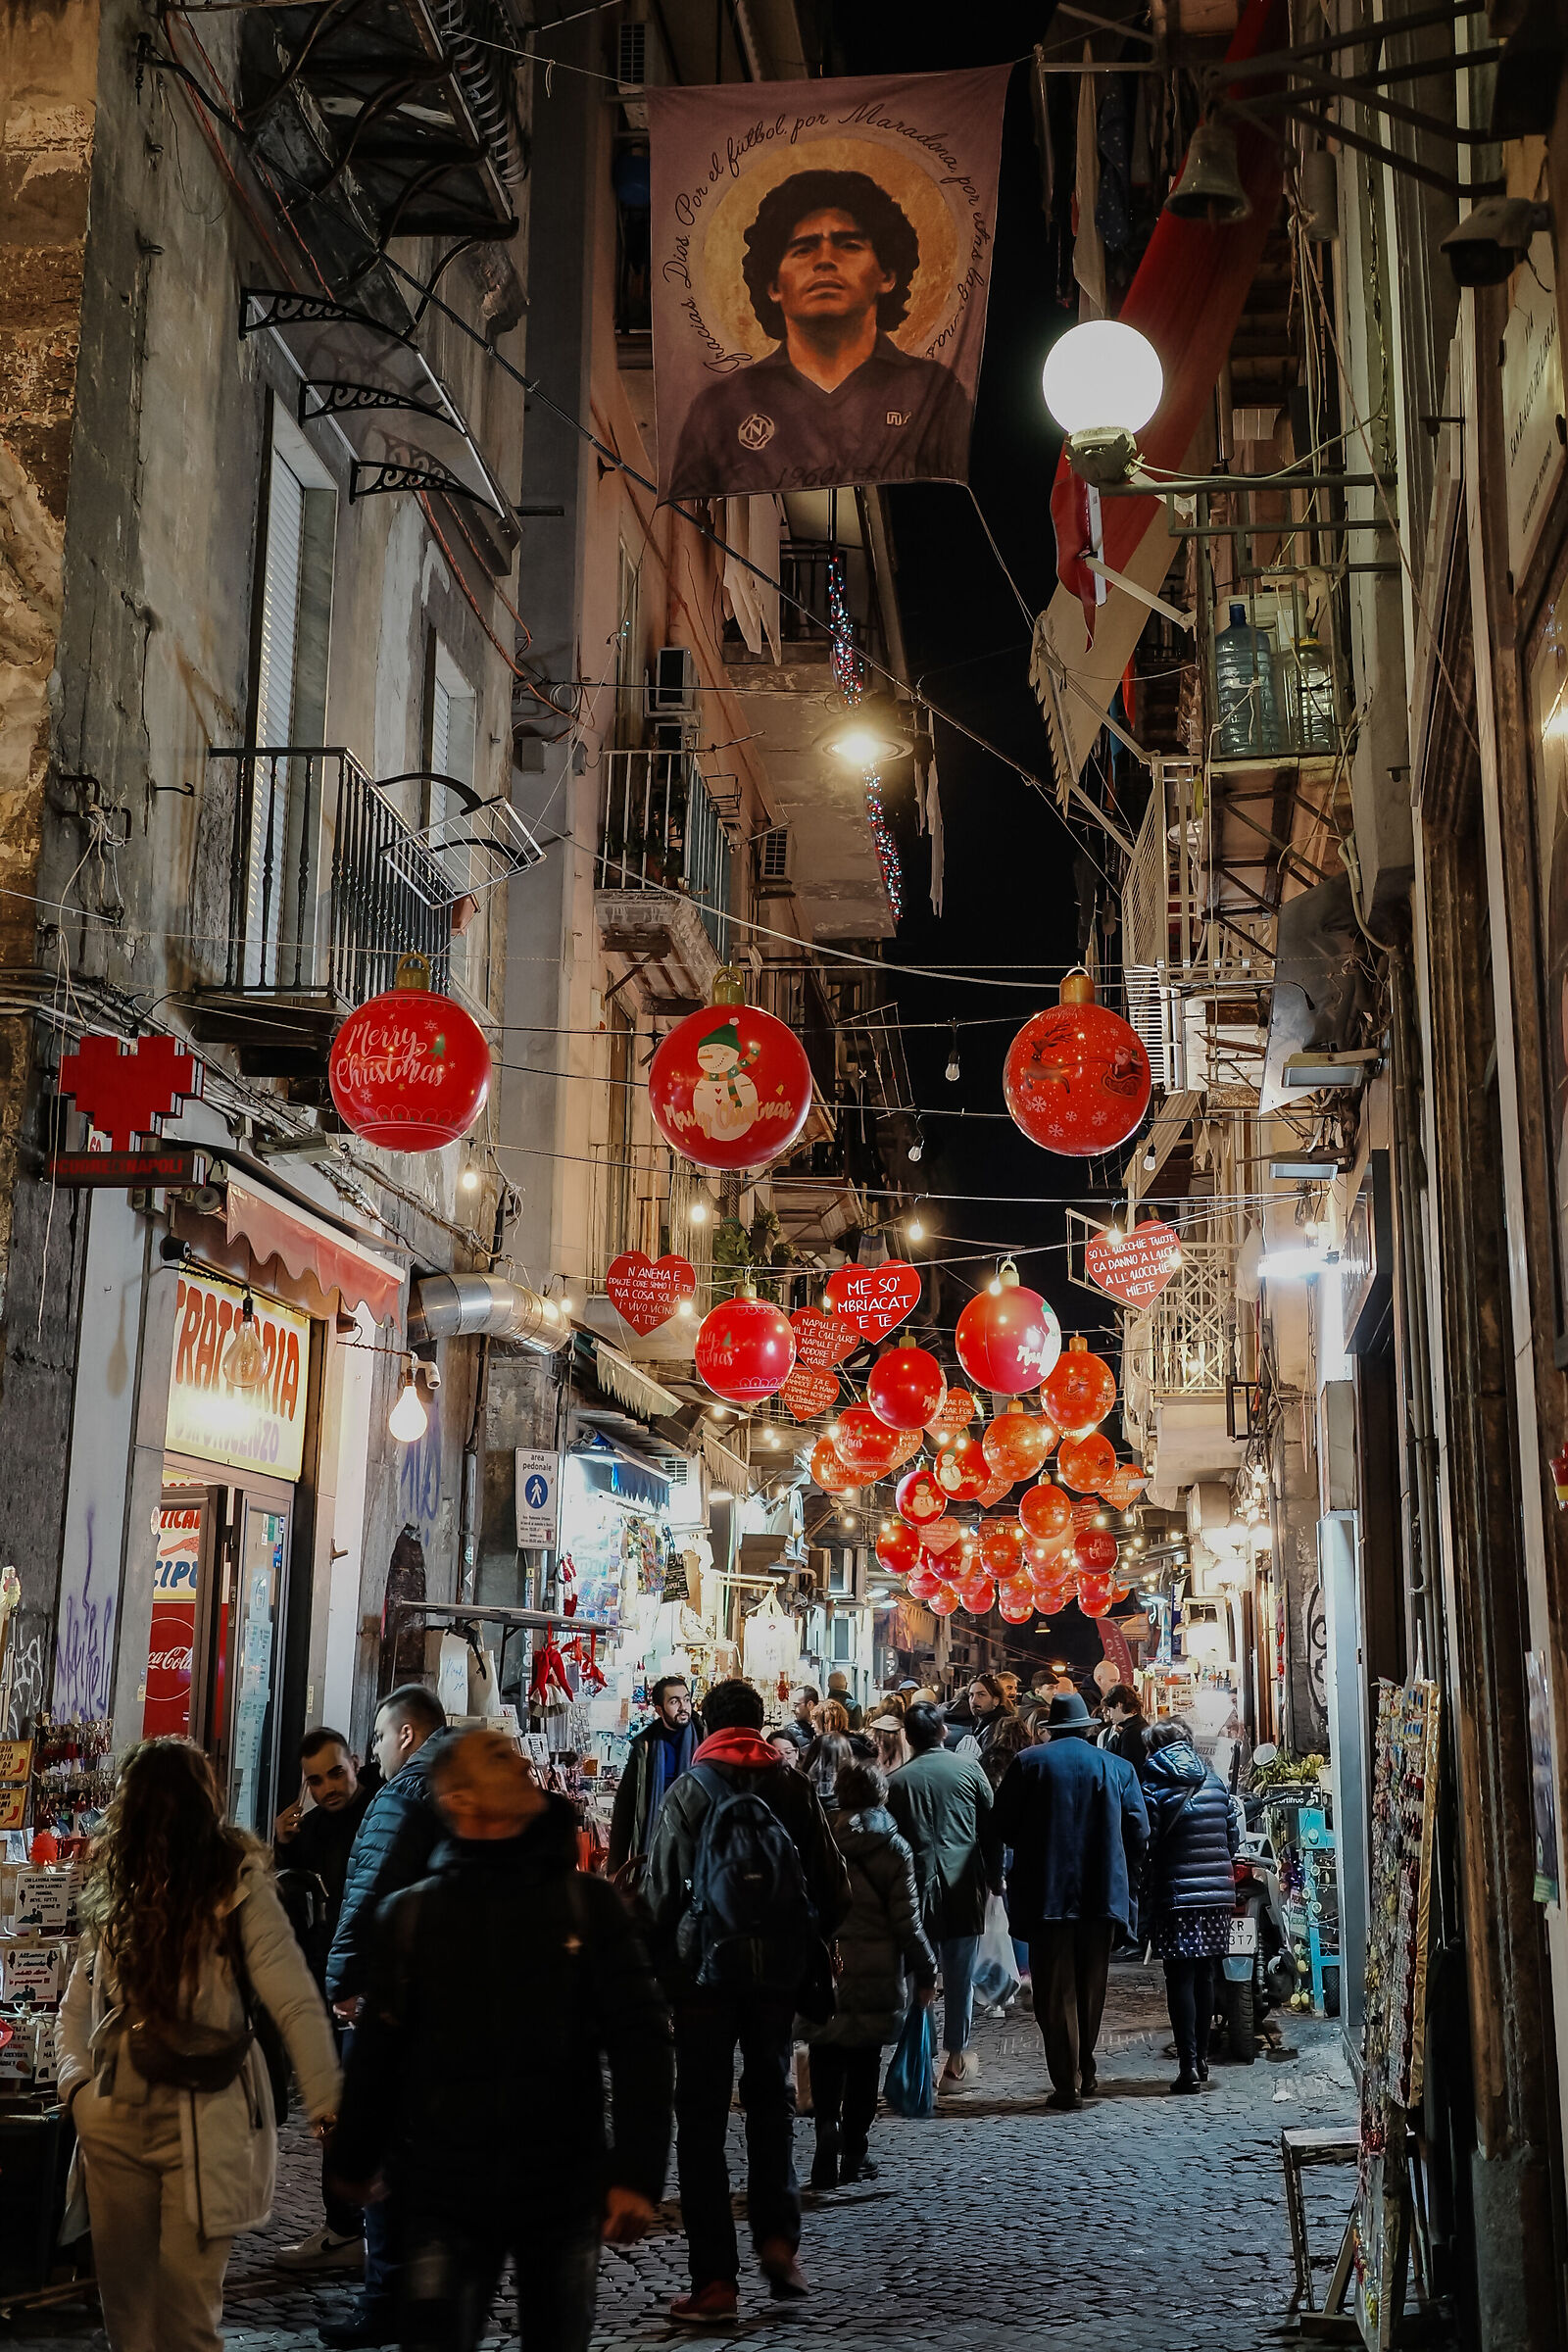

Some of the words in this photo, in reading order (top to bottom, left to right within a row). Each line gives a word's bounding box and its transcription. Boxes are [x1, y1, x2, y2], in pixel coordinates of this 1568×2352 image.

[675, 186, 709, 226] Por
[709, 152, 724, 182] el
[791, 113, 830, 145] por
[940, 174, 980, 207] por
[345, 1020, 427, 1062] Merry
[334, 1054, 446, 1094] Christmas
[1093, 1262, 1107, 1273] CA
[1107, 1253, 1138, 1270] DANNO
[632, 1279, 649, 1289] CORE
[673, 1270, 682, 1282] E
[614, 1287, 629, 1298] NA
[631, 1289, 655, 1300] COSA
[657, 1292, 681, 1303] SOLA
[847, 1278, 872, 1297] ME
[628, 1299, 648, 1312] VIVO
[650, 1302, 676, 1315] VICINO
[837, 1294, 912, 1313] MBRIACAT
[632, 1313, 640, 1324] A
[802, 1318, 839, 1331] NAPULE
[873, 1314, 893, 1328] TE
[801, 1338, 833, 1349] NAPULE
[806, 1356, 829, 1367] MARE
[522, 1462, 552, 1471] pedonale
[148, 1646, 193, 1670] ca-Cola
